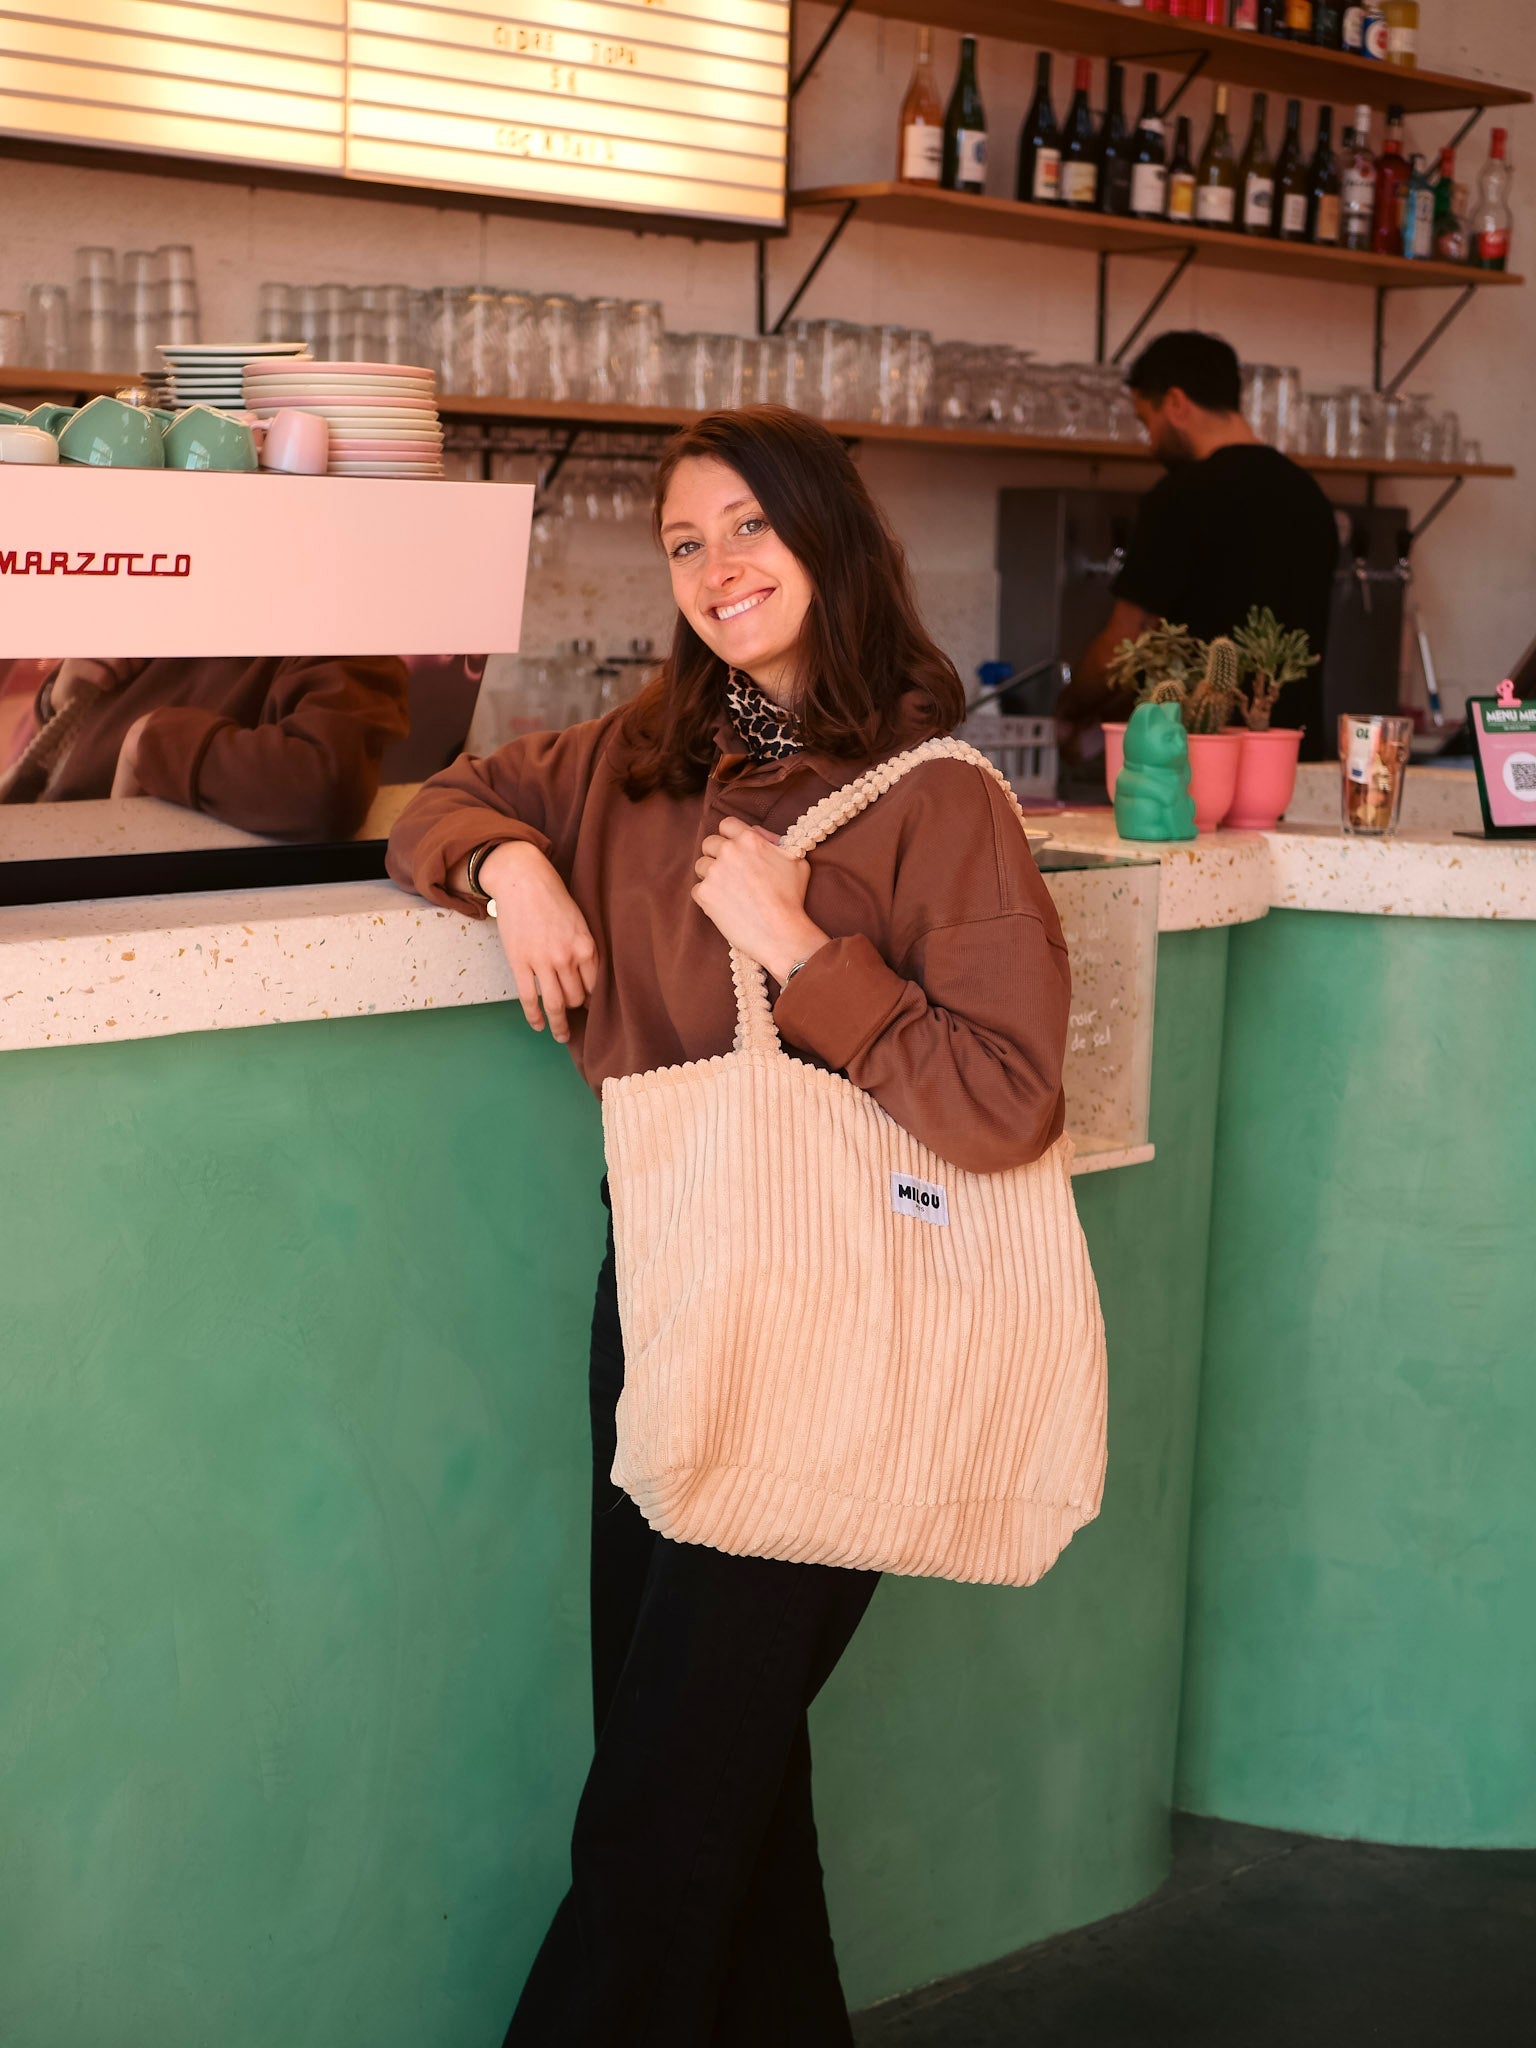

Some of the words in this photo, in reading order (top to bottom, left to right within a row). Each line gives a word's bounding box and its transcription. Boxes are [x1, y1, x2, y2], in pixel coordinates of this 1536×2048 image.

[0, 551, 190, 577] MARZOCCO
[1486, 709, 1518, 722] MENU
[1071, 1032, 1086, 1052] de
[1093, 1025, 1111, 1047] sel
[898, 1183, 940, 1209] MILOU
